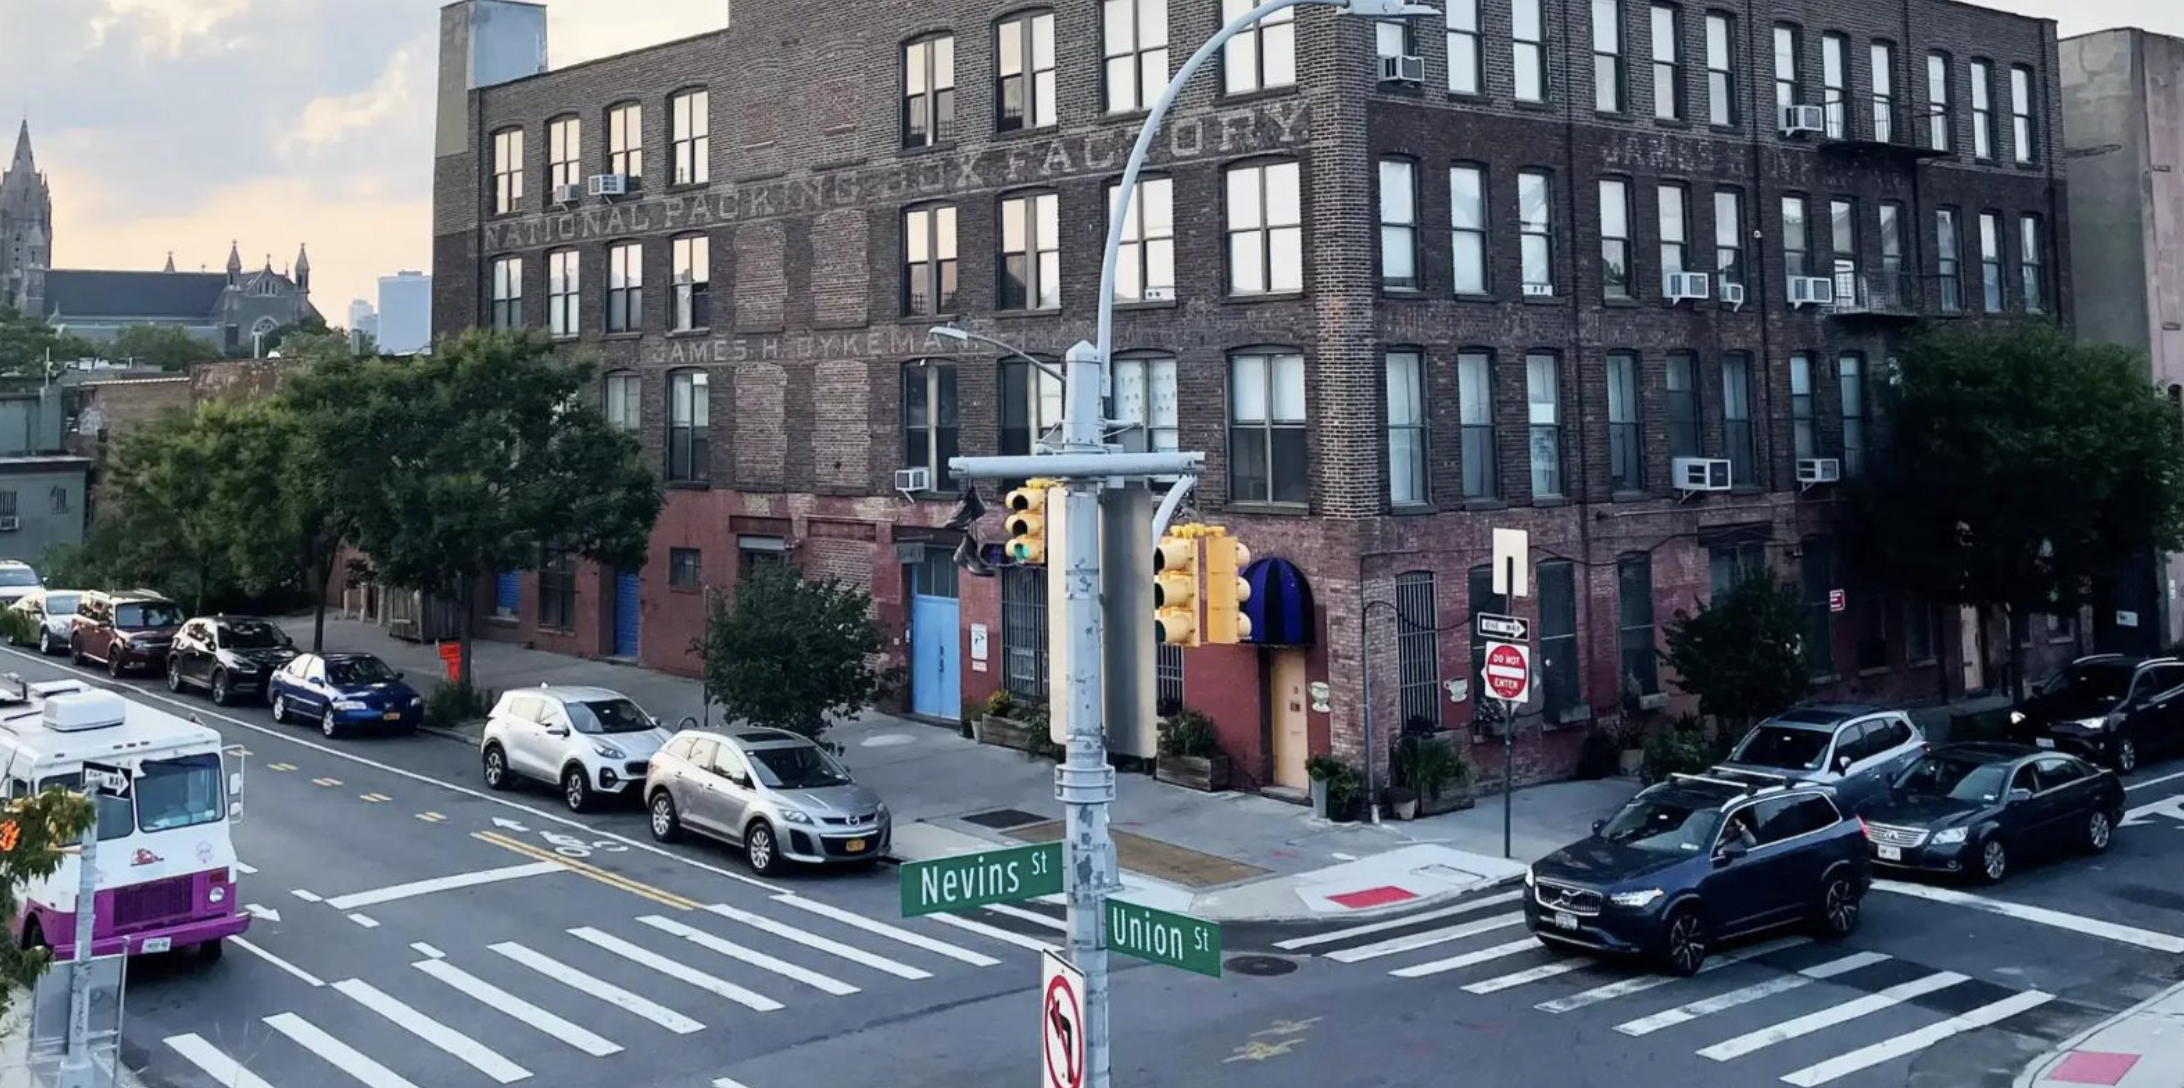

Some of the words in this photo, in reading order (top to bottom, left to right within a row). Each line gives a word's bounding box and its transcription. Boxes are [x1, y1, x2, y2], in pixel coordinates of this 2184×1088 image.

[484, 203, 650, 251] NATIONAL
[662, 172, 861, 228] PACKING
[796, 330, 970, 358] DYKEMA
[1484, 621, 1499, 630] ONE
[1505, 624, 1520, 633] WAY
[1493, 654, 1504, 663] DO
[1505, 656, 1521, 666] NOT
[1494, 678, 1518, 690] ENTER
[921, 855, 1020, 906] Nevins
[1031, 851, 1048, 876] St
[1112, 906, 1184, 961] Union
[1194, 926, 1210, 952] St
